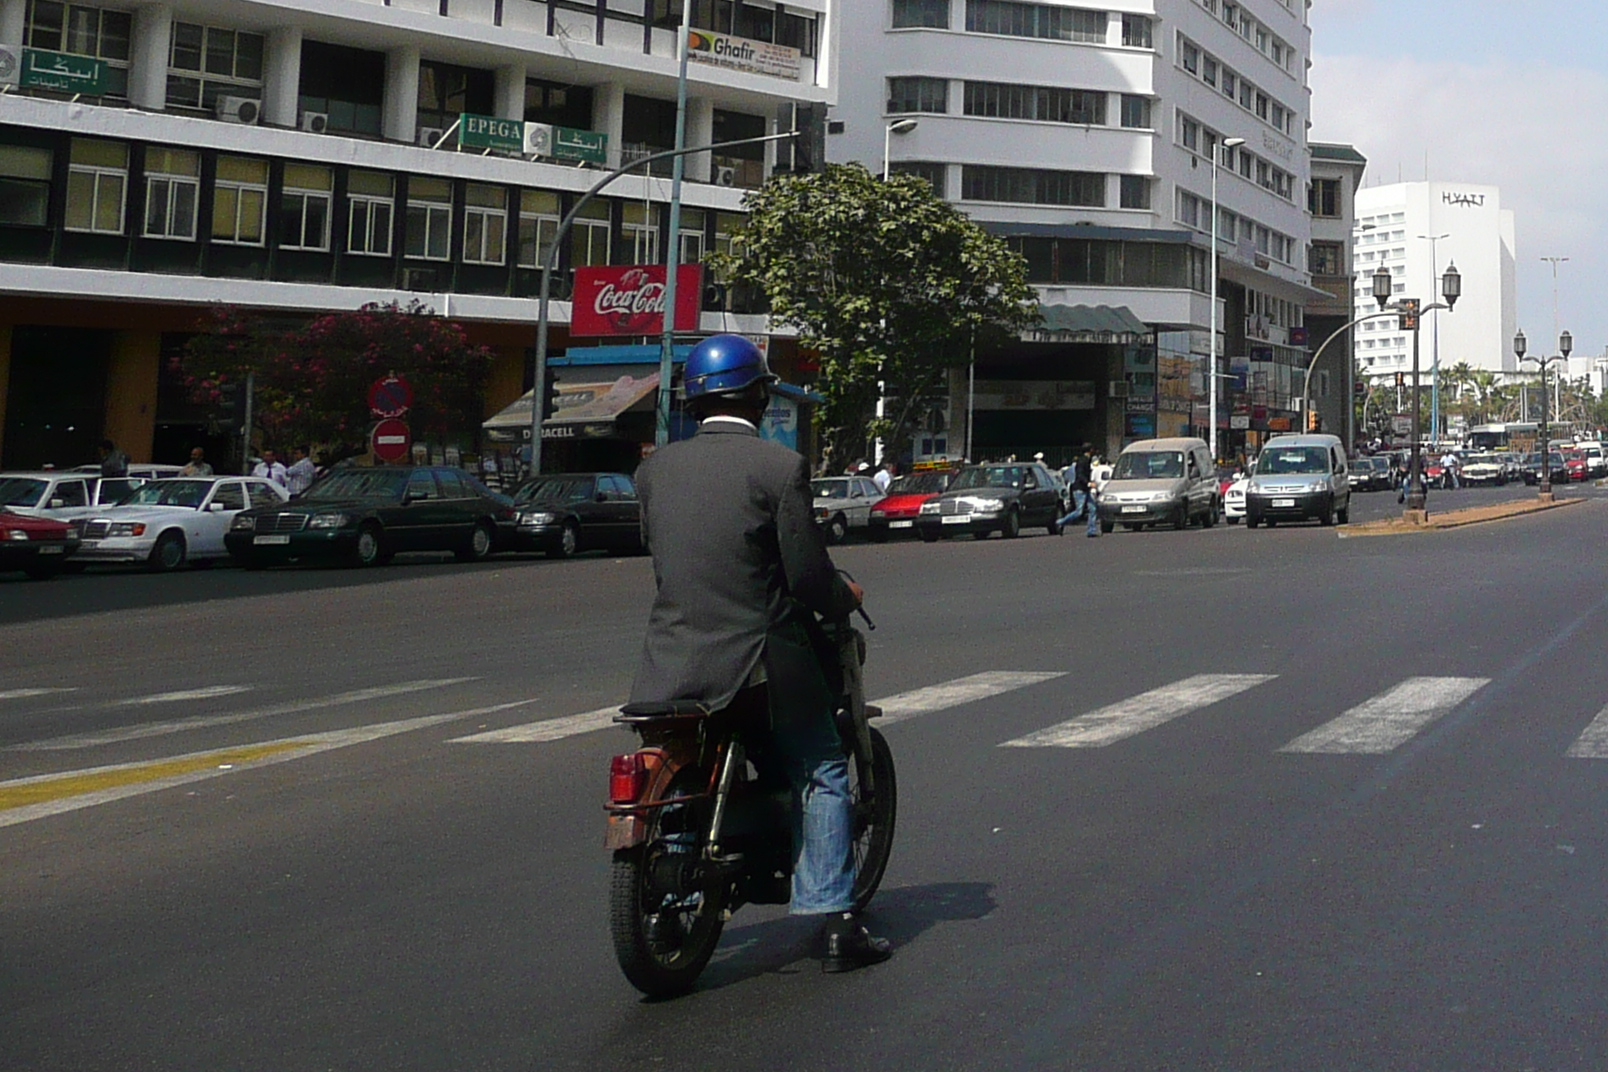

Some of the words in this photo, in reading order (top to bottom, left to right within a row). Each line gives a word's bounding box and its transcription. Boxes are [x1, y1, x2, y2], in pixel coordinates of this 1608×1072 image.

[714, 37, 755, 60] Ghafir
[468, 117, 521, 139] EPEGA
[1442, 191, 1485, 208] HYATT
[594, 282, 665, 315] Coca-Col
[523, 427, 575, 439] DRACELL
